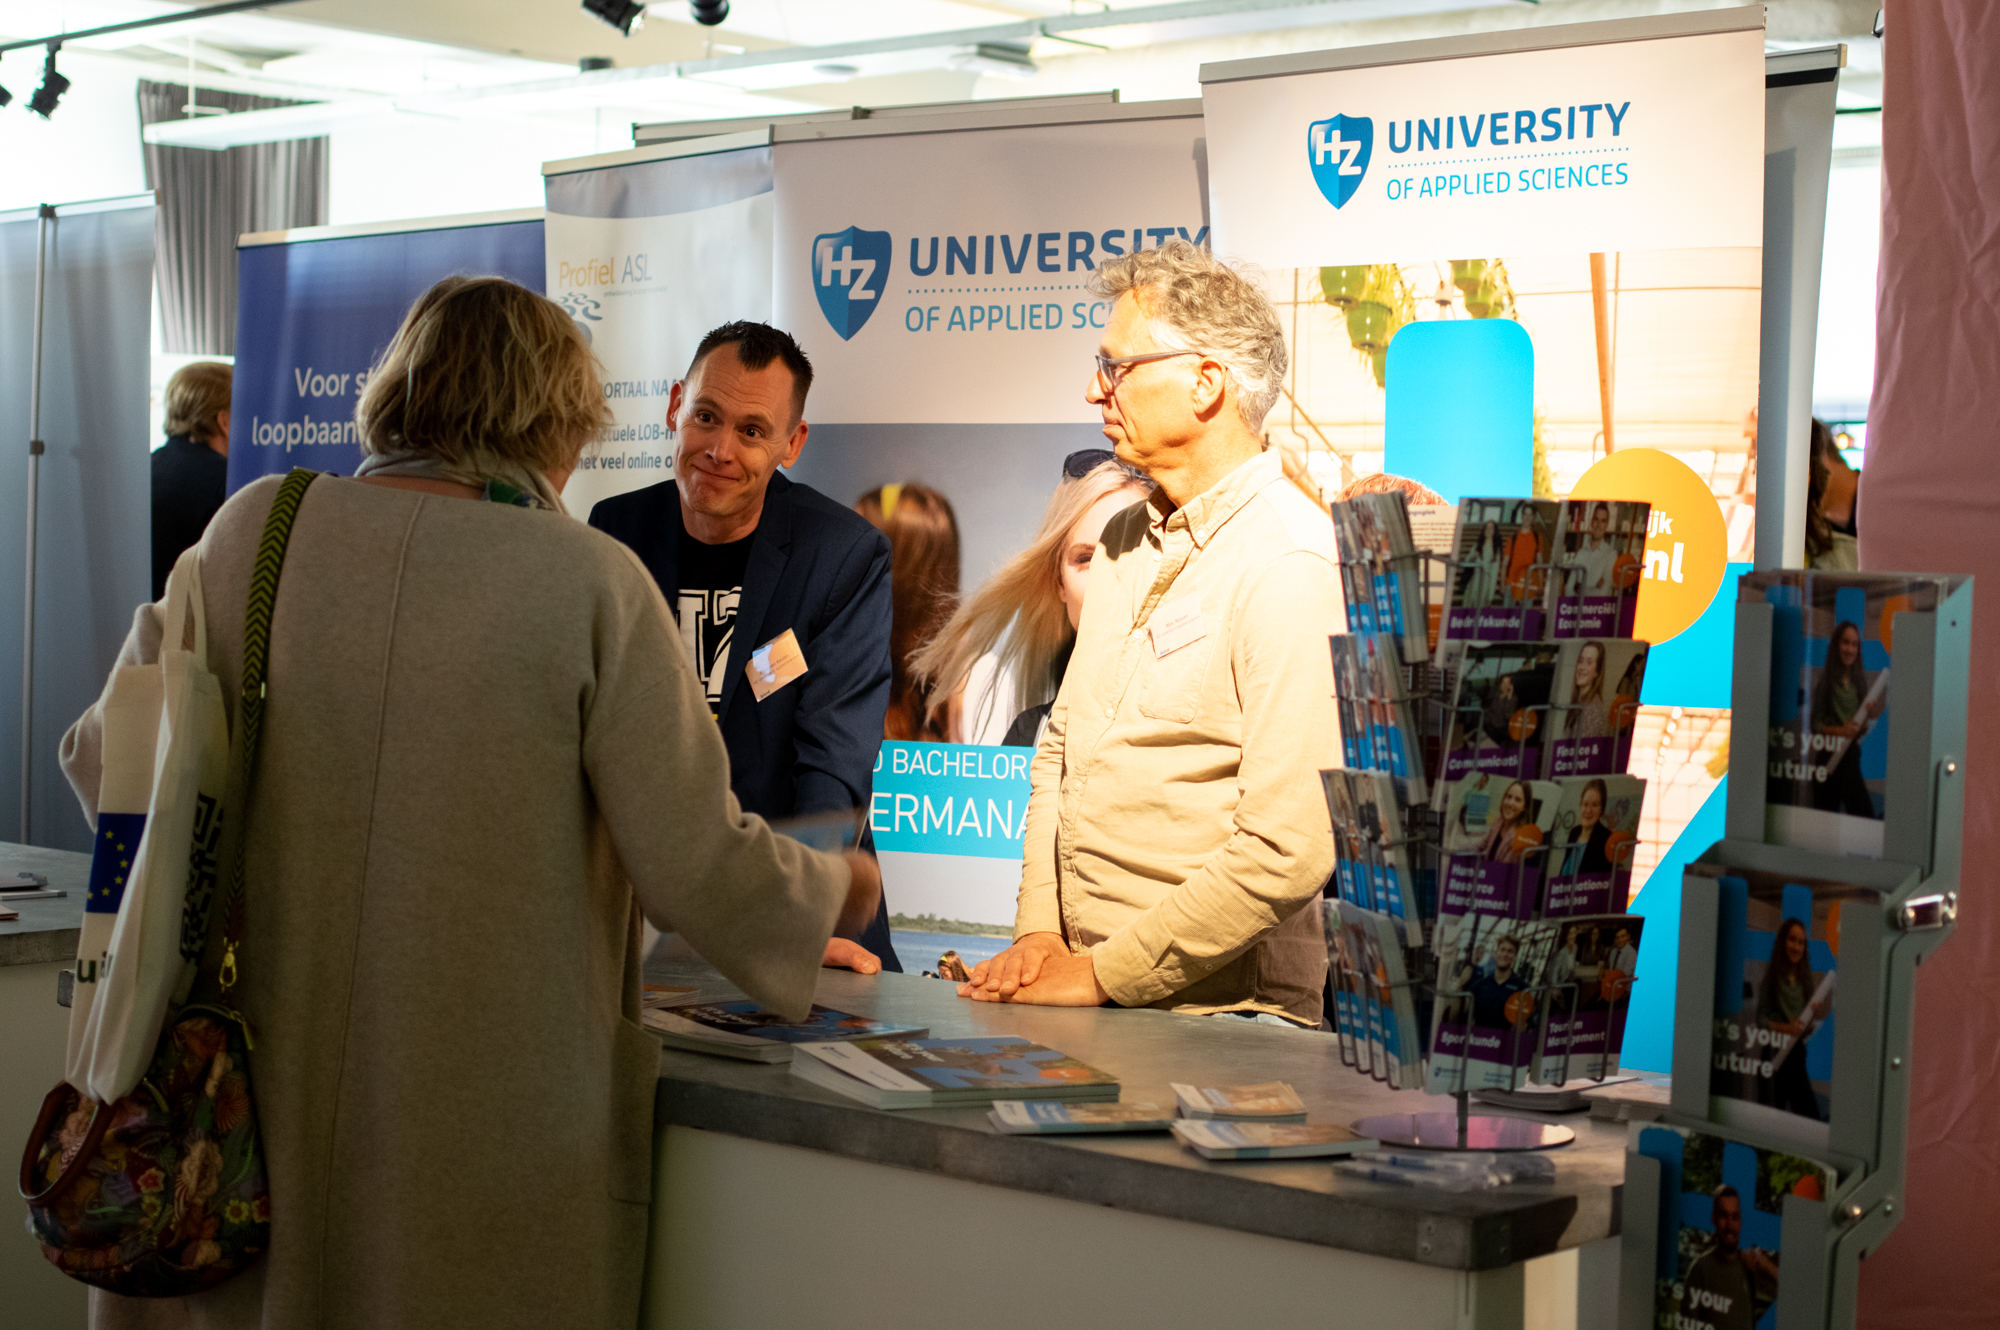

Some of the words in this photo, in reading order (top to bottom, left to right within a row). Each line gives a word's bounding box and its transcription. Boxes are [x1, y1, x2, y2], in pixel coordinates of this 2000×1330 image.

[1388, 101, 1631, 153] UNIVERSITY
[1316, 129, 1361, 176] HZ
[1387, 178, 1414, 200] OF
[1419, 171, 1510, 198] APPLIED
[1518, 162, 1628, 192] SCIENCES
[559, 257, 615, 288] Profiel
[621, 253, 652, 283] ASL
[821, 246, 876, 300] HZ
[905, 305, 940, 332] OF
[947, 303, 1063, 332] APPLIED
[295, 367, 350, 397] Voor
[355, 367, 373, 396] s
[602, 379, 649, 399] ORTAAL
[651, 378, 677, 396] NA
[252, 414, 357, 453] loopbaan
[600, 452, 625, 469] veel
[627, 451, 662, 469] online
[1556, 745, 1590, 758] Finace
[1800, 732, 1845, 756] your
[892, 748, 1027, 780] BACHELOR
[1769, 759, 1828, 783] uture
[1745, 1026, 1792, 1050] your
[1713, 1051, 1774, 1079] uture
[1689, 1286, 1734, 1314] your
[1658, 1312, 1716, 1330] uture
